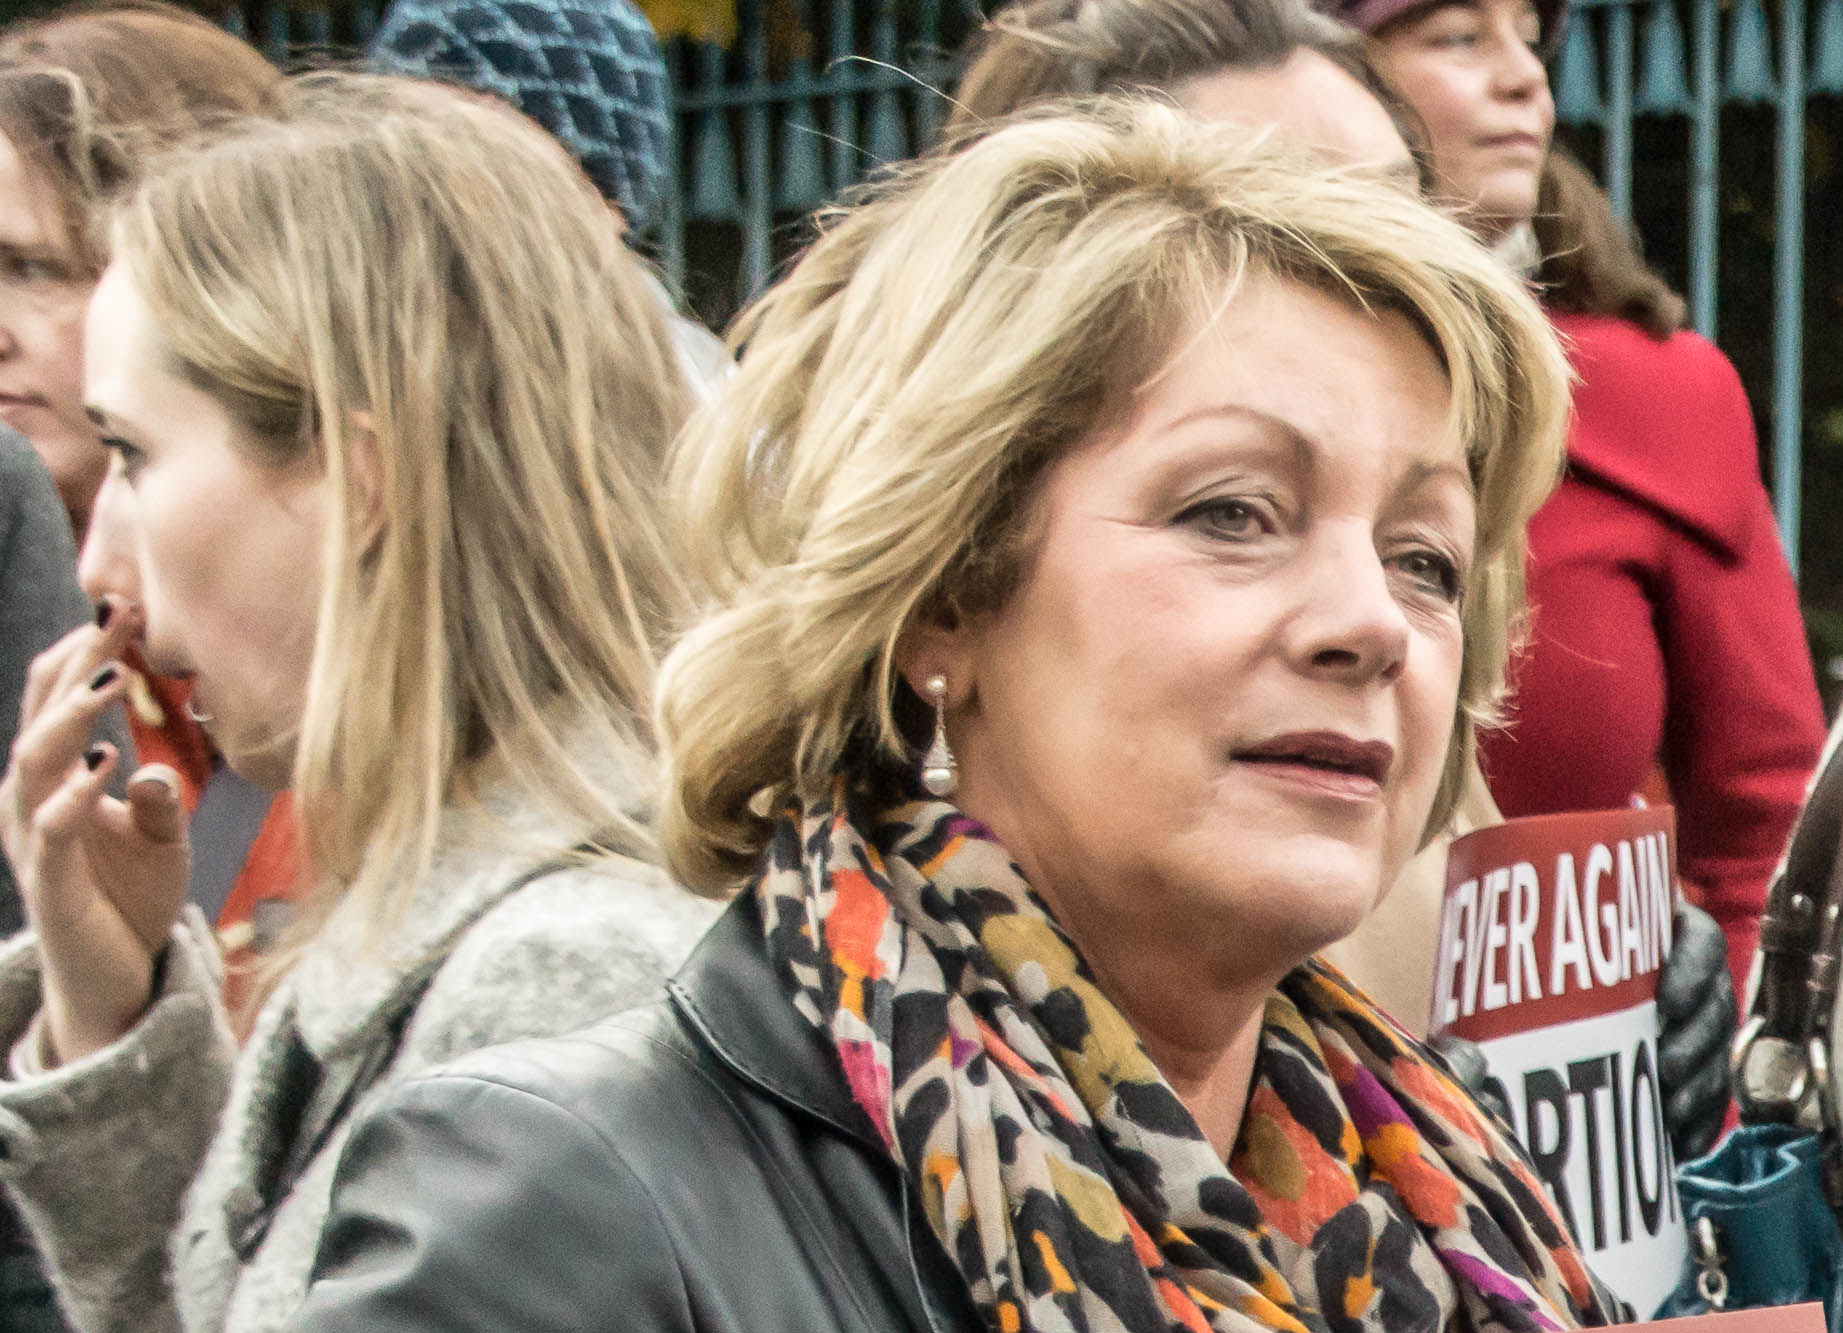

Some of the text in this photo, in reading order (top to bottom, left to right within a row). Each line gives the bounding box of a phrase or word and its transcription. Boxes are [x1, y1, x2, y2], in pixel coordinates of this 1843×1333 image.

[1434, 831, 1672, 1025] EVER AGAIN
[1482, 1038, 1677, 1252] RTIO
